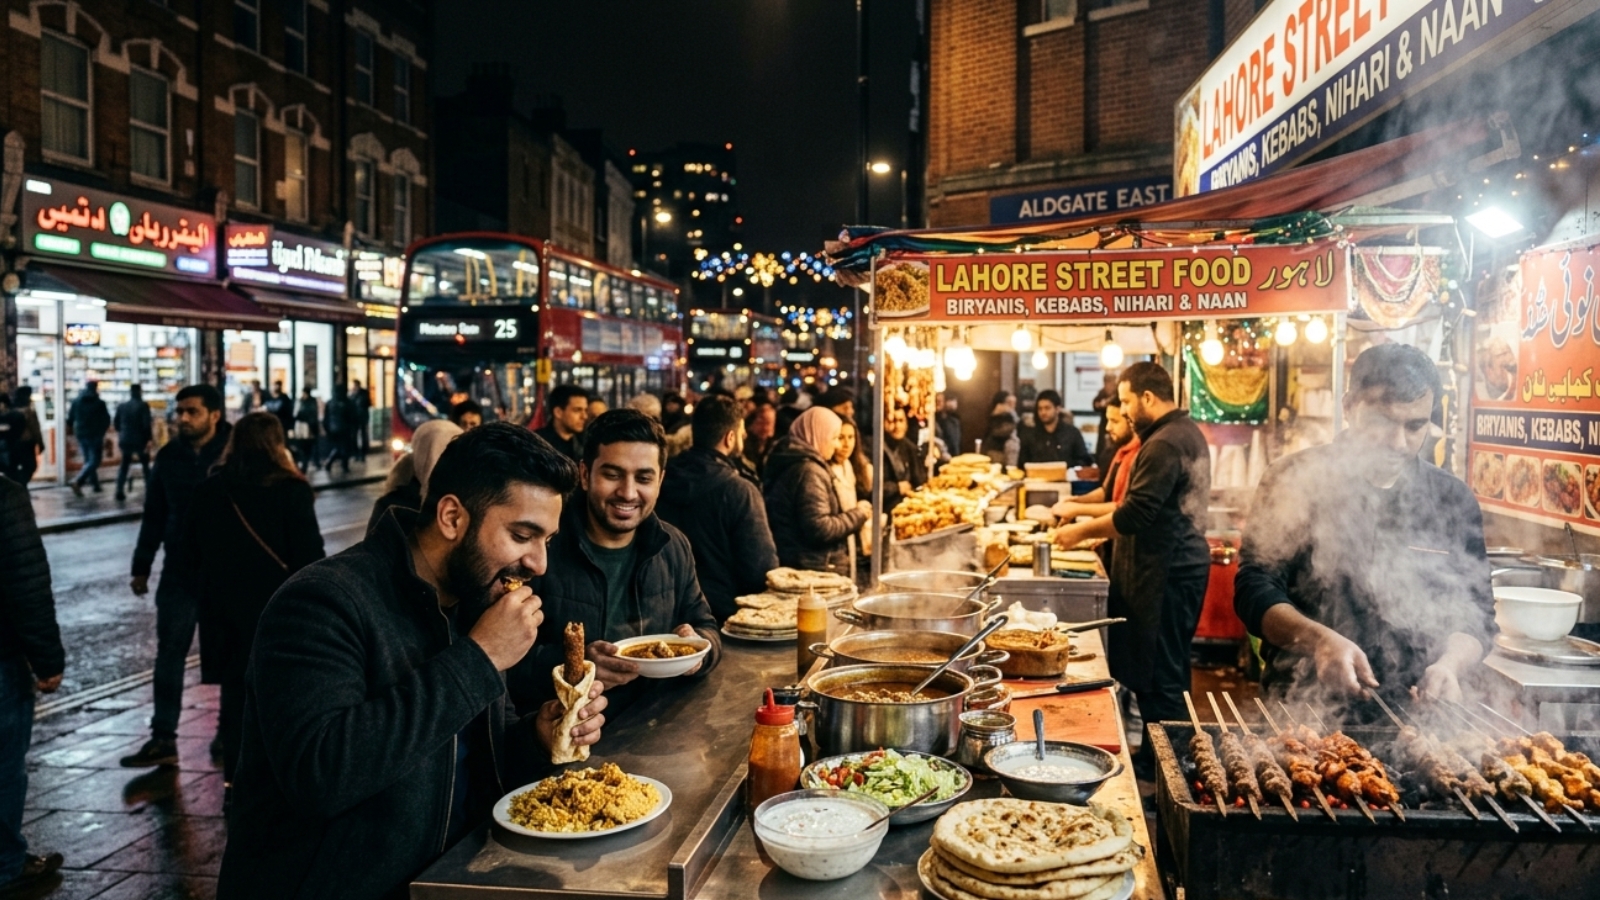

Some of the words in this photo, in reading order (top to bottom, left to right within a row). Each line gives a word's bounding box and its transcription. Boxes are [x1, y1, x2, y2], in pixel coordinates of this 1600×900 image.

[1202, 33, 1275, 160] LAHORE
[1261, 99, 1321, 168] KEBABS,
[1325, 44, 1390, 126] NIHARI
[1395, 30, 1412, 80] &
[1420, 0, 1503, 66] NAAN
[1018, 191, 1108, 219] ALDGATE
[1117, 184, 1170, 208] EAST
[936, 262, 1048, 293] LAHORE
[1055, 259, 1165, 291] STREET
[1172, 257, 1252, 288] FOOD
[1257, 250, 1335, 291] لاہور
[946, 298, 1030, 317] BIRYANIS,
[1035, 297, 1109, 317] KEBABS,
[1113, 295, 1174, 313] NIHARI
[1178, 294, 1192, 311] &
[1198, 292, 1247, 310] NAAN
[494, 318, 517, 339] 25
[1531, 417, 1585, 450] KEBABS,
